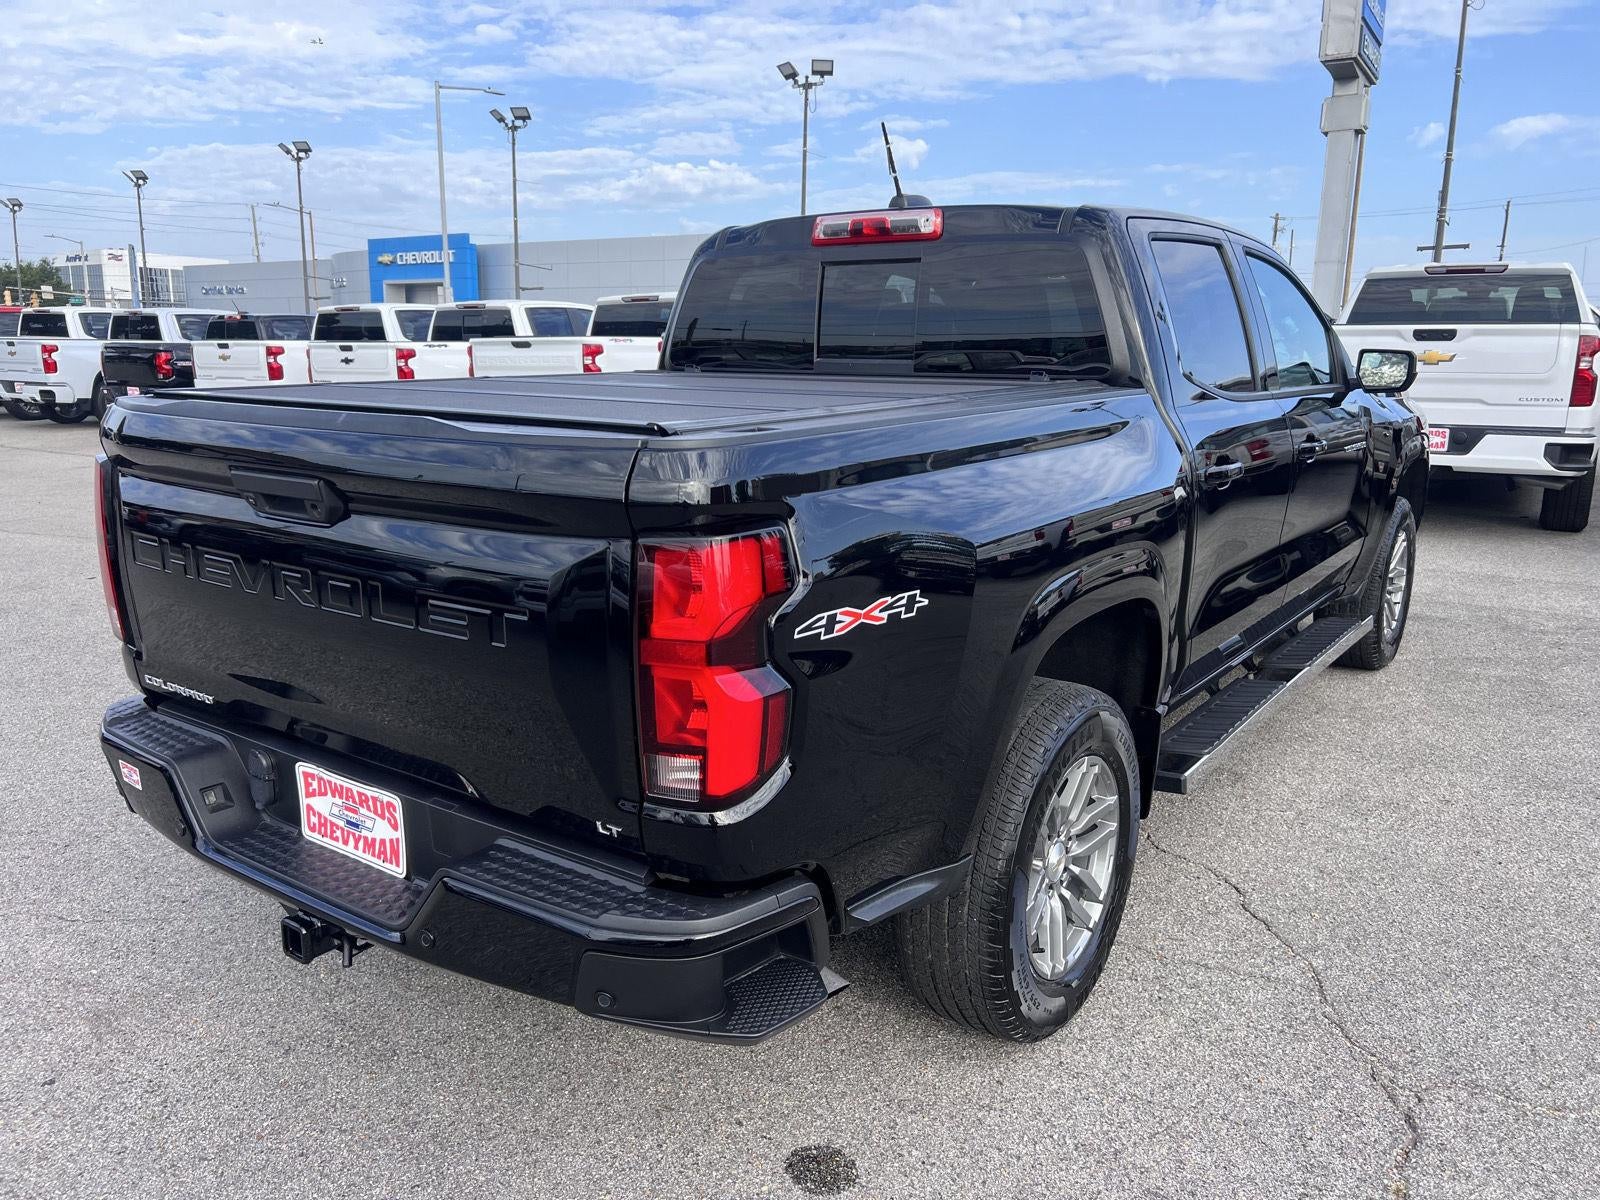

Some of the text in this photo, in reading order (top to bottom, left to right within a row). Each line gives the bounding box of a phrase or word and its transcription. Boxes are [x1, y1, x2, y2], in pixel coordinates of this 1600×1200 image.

[397, 250, 455, 264] CHEVROLT
[133, 531, 529, 648] CHEVROLET
[144, 674, 215, 704] COLORADO
[302, 770, 399, 832] EDWARDS
[338, 808, 367, 825] Chevrolet
[595, 820, 624, 838] LT
[305, 803, 401, 869] CHEVYMAN
